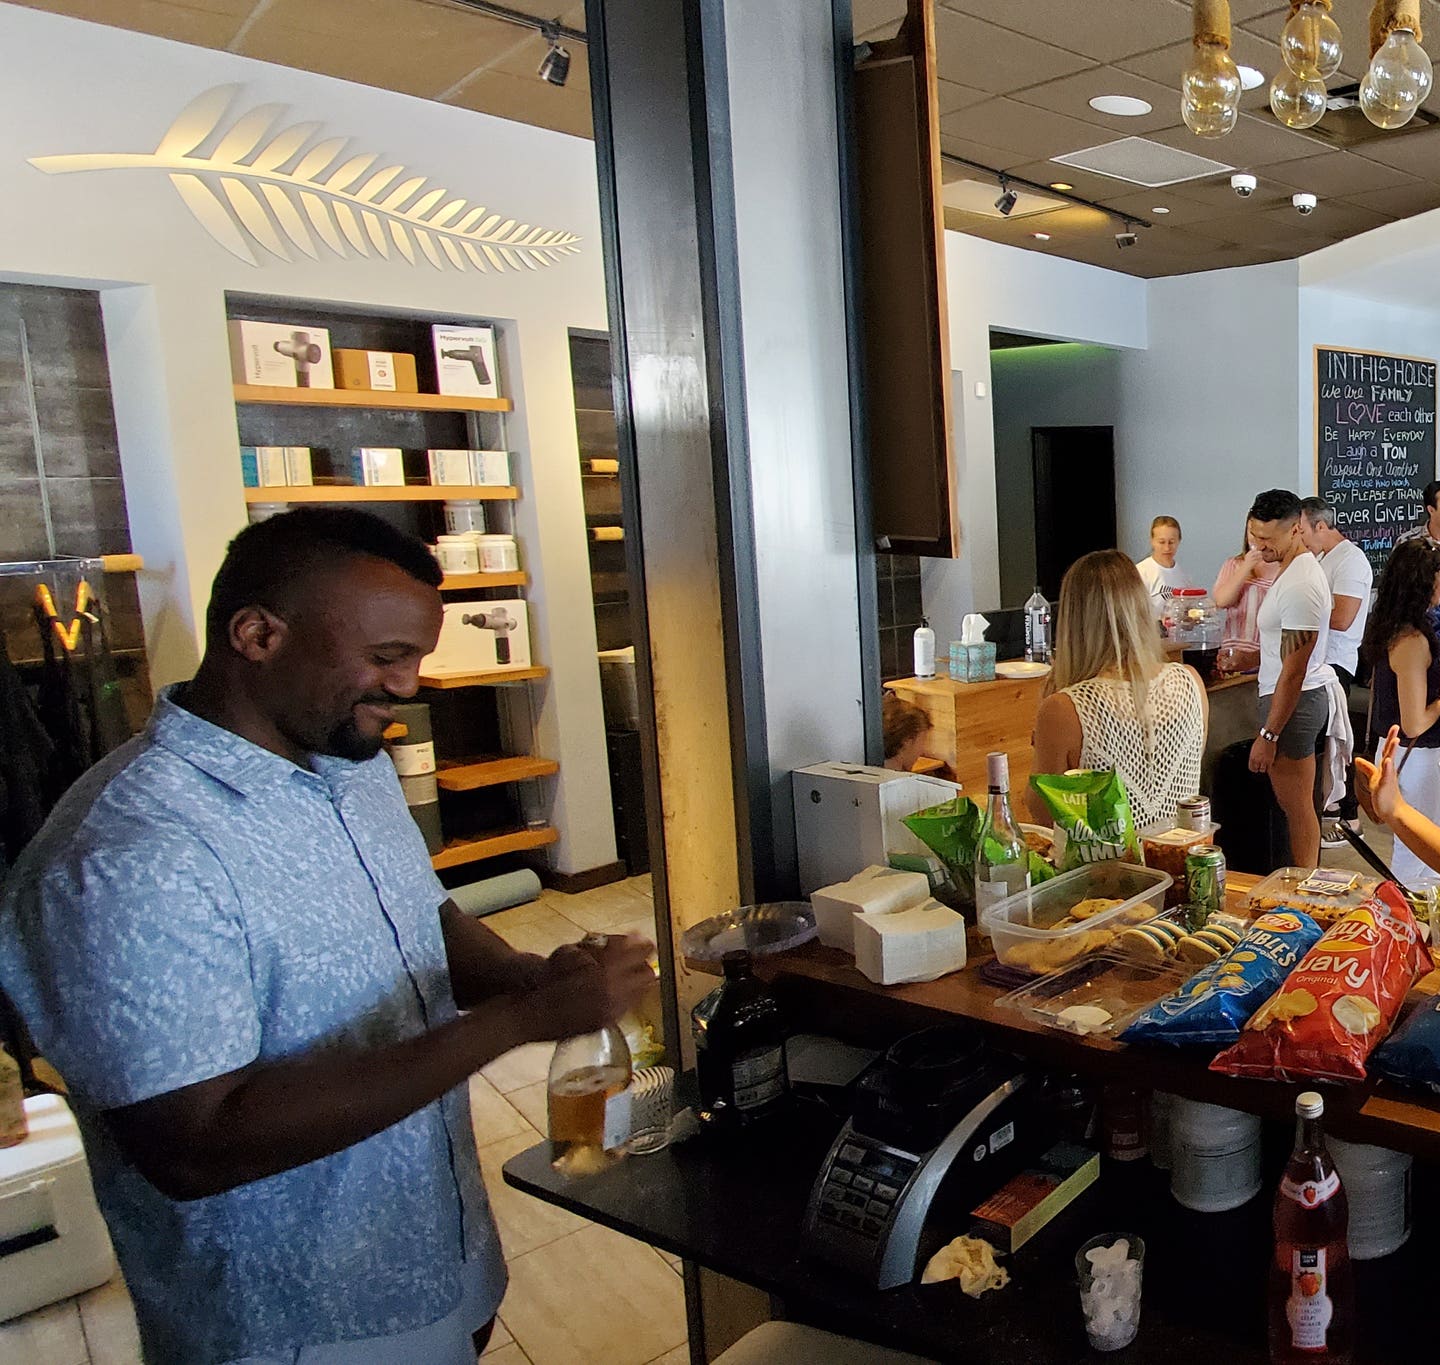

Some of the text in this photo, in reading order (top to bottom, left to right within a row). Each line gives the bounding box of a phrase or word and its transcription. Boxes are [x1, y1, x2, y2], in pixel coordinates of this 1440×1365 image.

[1394, 360, 1435, 388] HOUSE
[1321, 384, 1341, 399] We
[1371, 385, 1413, 403] FAMILY
[1388, 407, 1412, 423] each
[1414, 407, 1435, 424] other
[1336, 441, 1407, 460] Laugh a TON
[1324, 457, 1363, 482] Respect
[1366, 461, 1383, 477] One
[1352, 488, 1387, 503] PLEASE
[1375, 503, 1404, 523] GIVE
[1408, 503, 1424, 521] UP
[1296, 974, 1339, 985] Original
